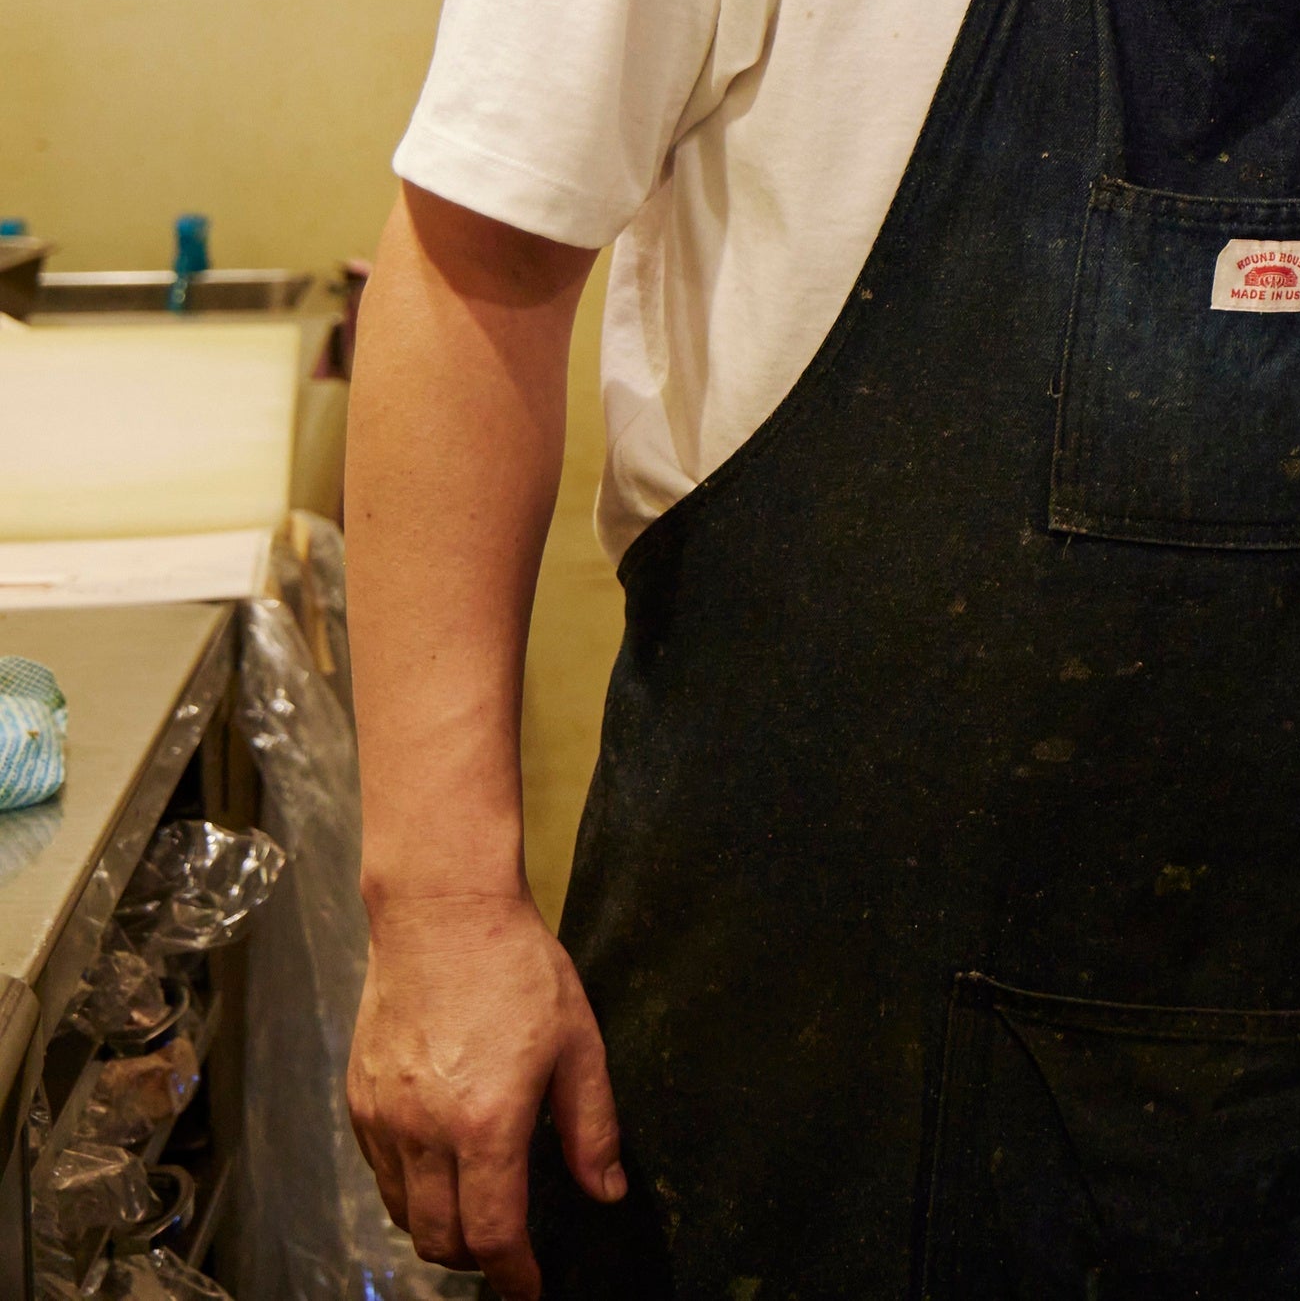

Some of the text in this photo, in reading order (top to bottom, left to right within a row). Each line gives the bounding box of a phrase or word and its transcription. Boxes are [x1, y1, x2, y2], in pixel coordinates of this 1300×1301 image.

[1236, 251, 1275, 270] ROUND
[1231, 288, 1265, 300] MADE
[1271, 290, 1283, 300] IN
